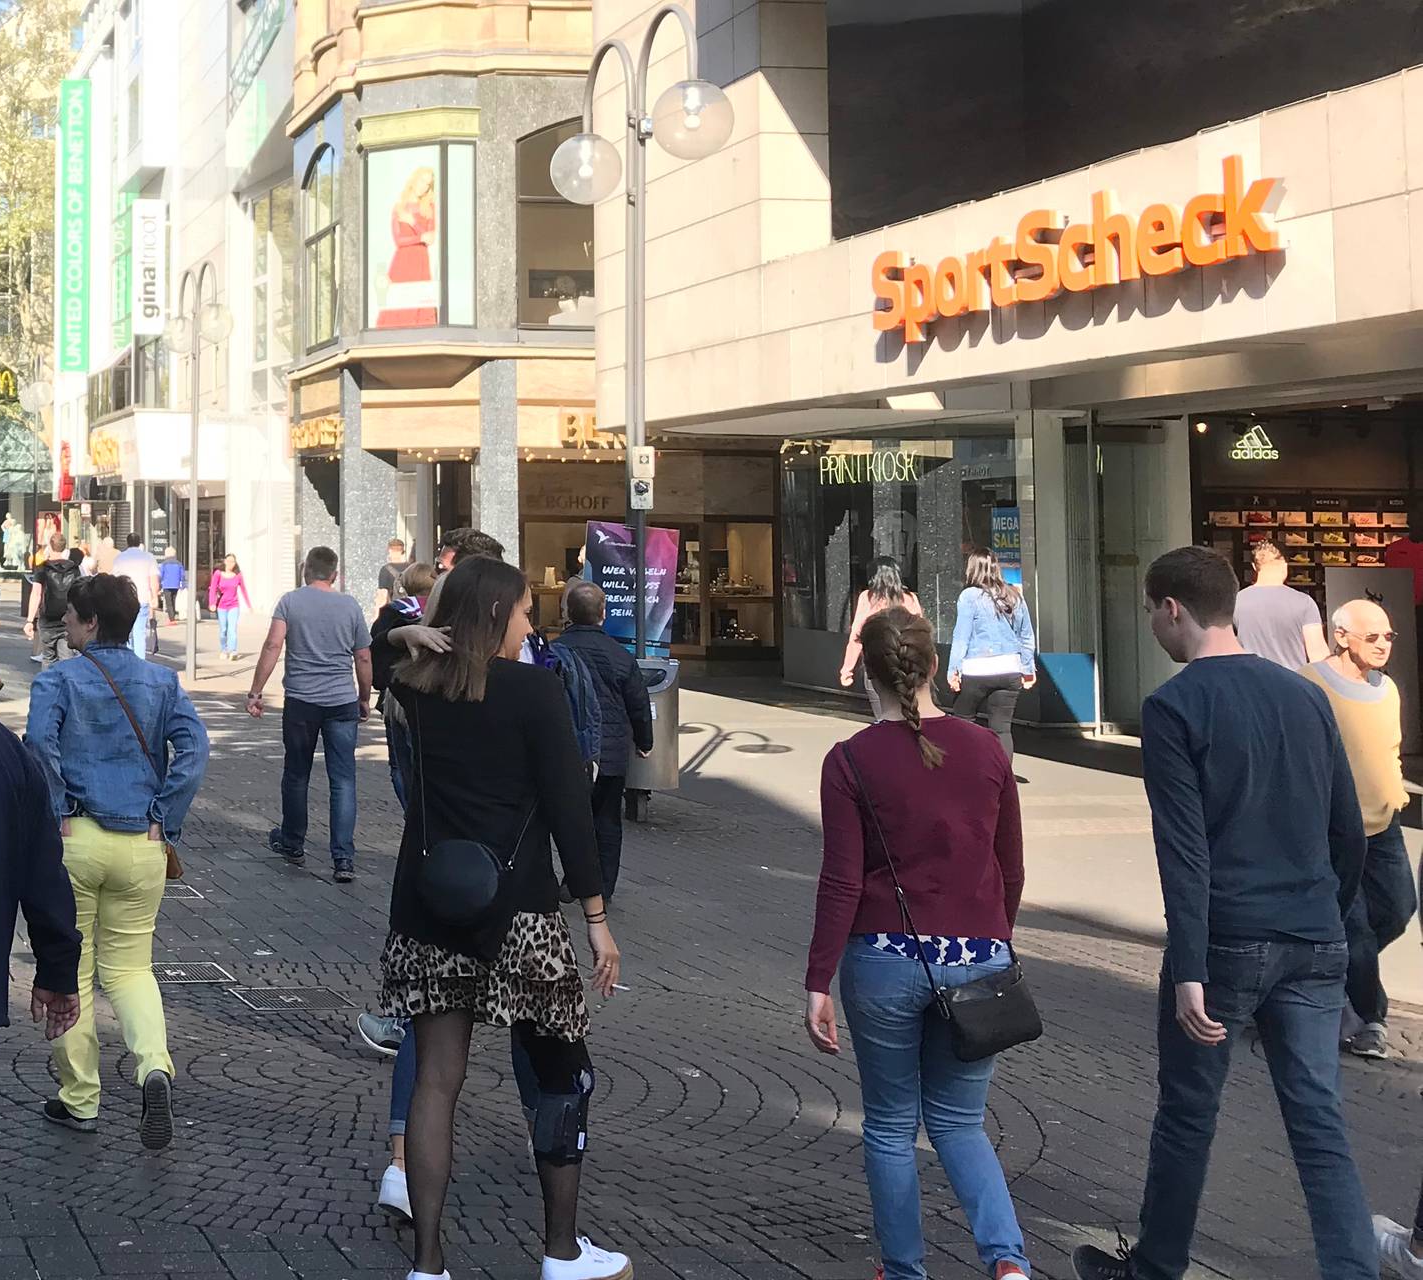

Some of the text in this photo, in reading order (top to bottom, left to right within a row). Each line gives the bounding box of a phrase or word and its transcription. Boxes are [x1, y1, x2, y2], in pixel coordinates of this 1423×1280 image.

[65, 87, 85, 367] UNITED COLORS OF BENETTON
[871, 153, 1283, 343] SportScheck
[1231, 448, 1280, 460] adidas
[820, 449, 919, 486] PRINT KIOSK
[992, 516, 1019, 531] MEGA
[993, 533, 1020, 548] SALE
[602, 565, 626, 576] WER
[602, 581, 629, 590] WILL,
[610, 608, 634, 617] SEIN.
